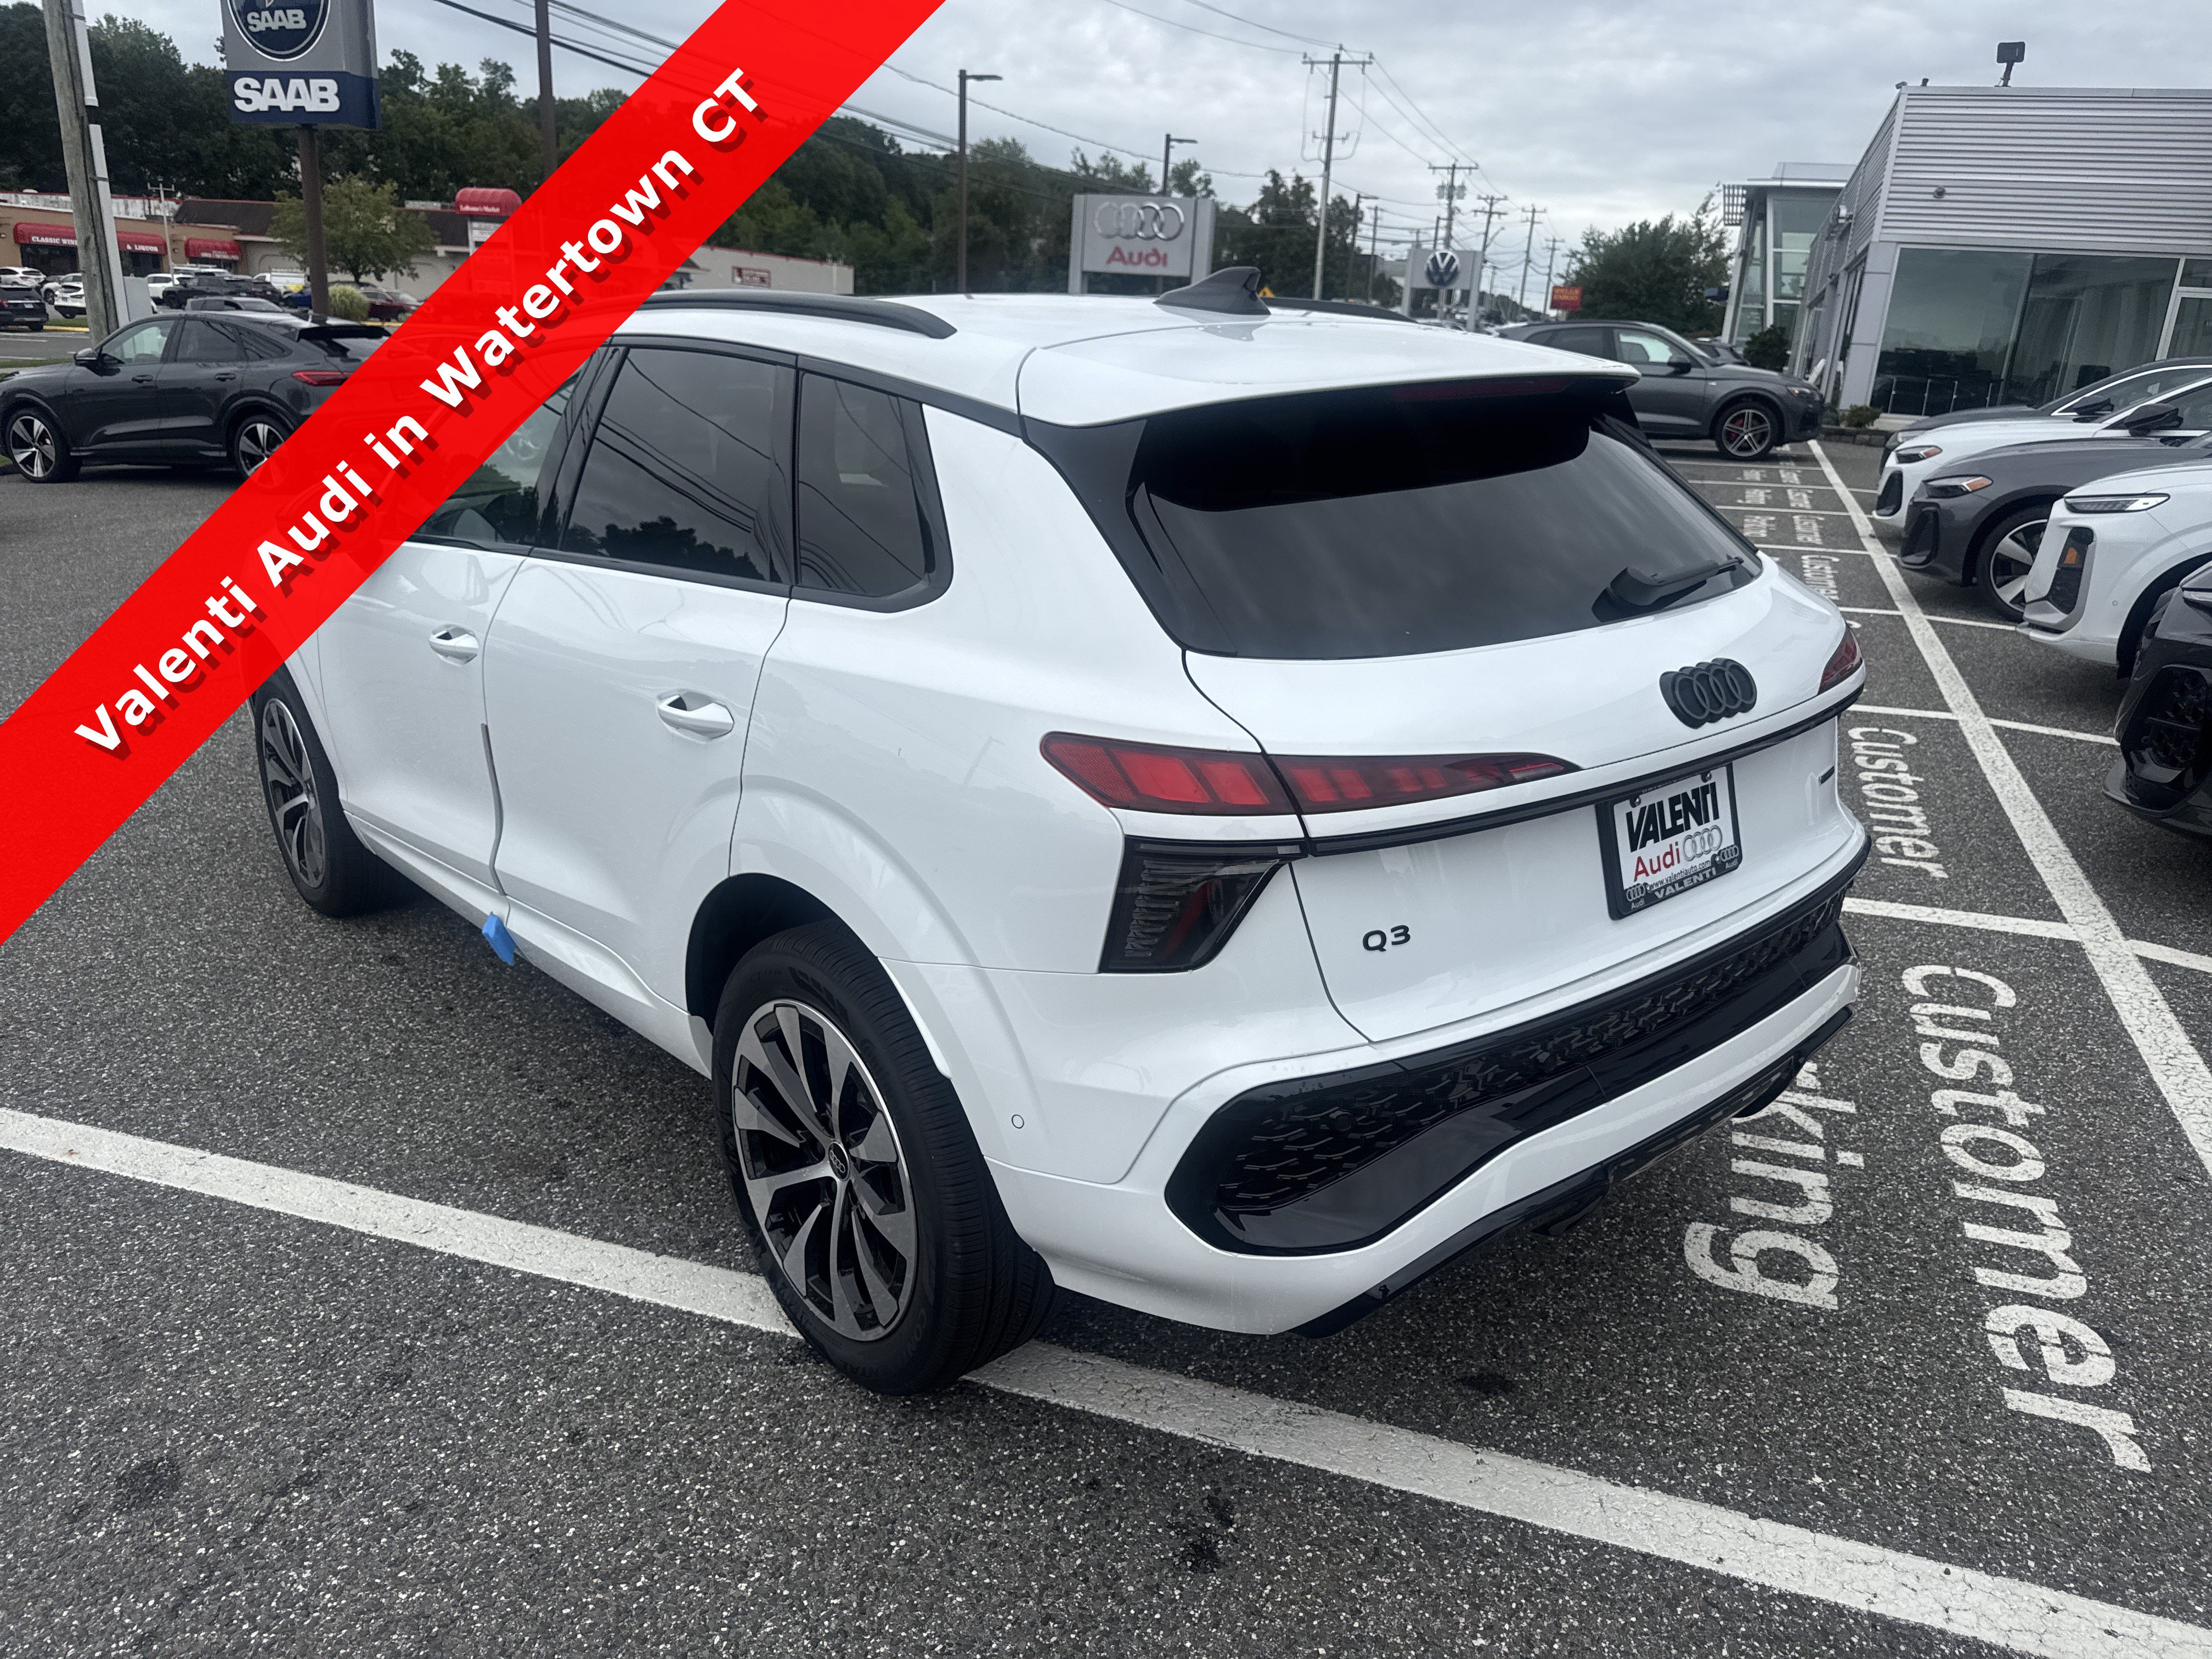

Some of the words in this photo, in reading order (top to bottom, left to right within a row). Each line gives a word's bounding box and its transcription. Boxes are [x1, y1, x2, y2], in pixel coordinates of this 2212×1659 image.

[247, 9, 307, 32] SAAB
[234, 77, 340, 112] SAAB
[31, 236, 60, 244] CLASSIC
[1106, 245, 1168, 267] Audi
[1626, 781, 1719, 853] VALENTI
[1848, 727, 1948, 878] Customer
[1633, 842, 1680, 882] Audi
[1655, 867, 1716, 899] VALENTI
[1363, 924, 1410, 952] Q3
[1684, 1060, 1864, 1310] king
[1901, 964, 2152, 1474] Customer
